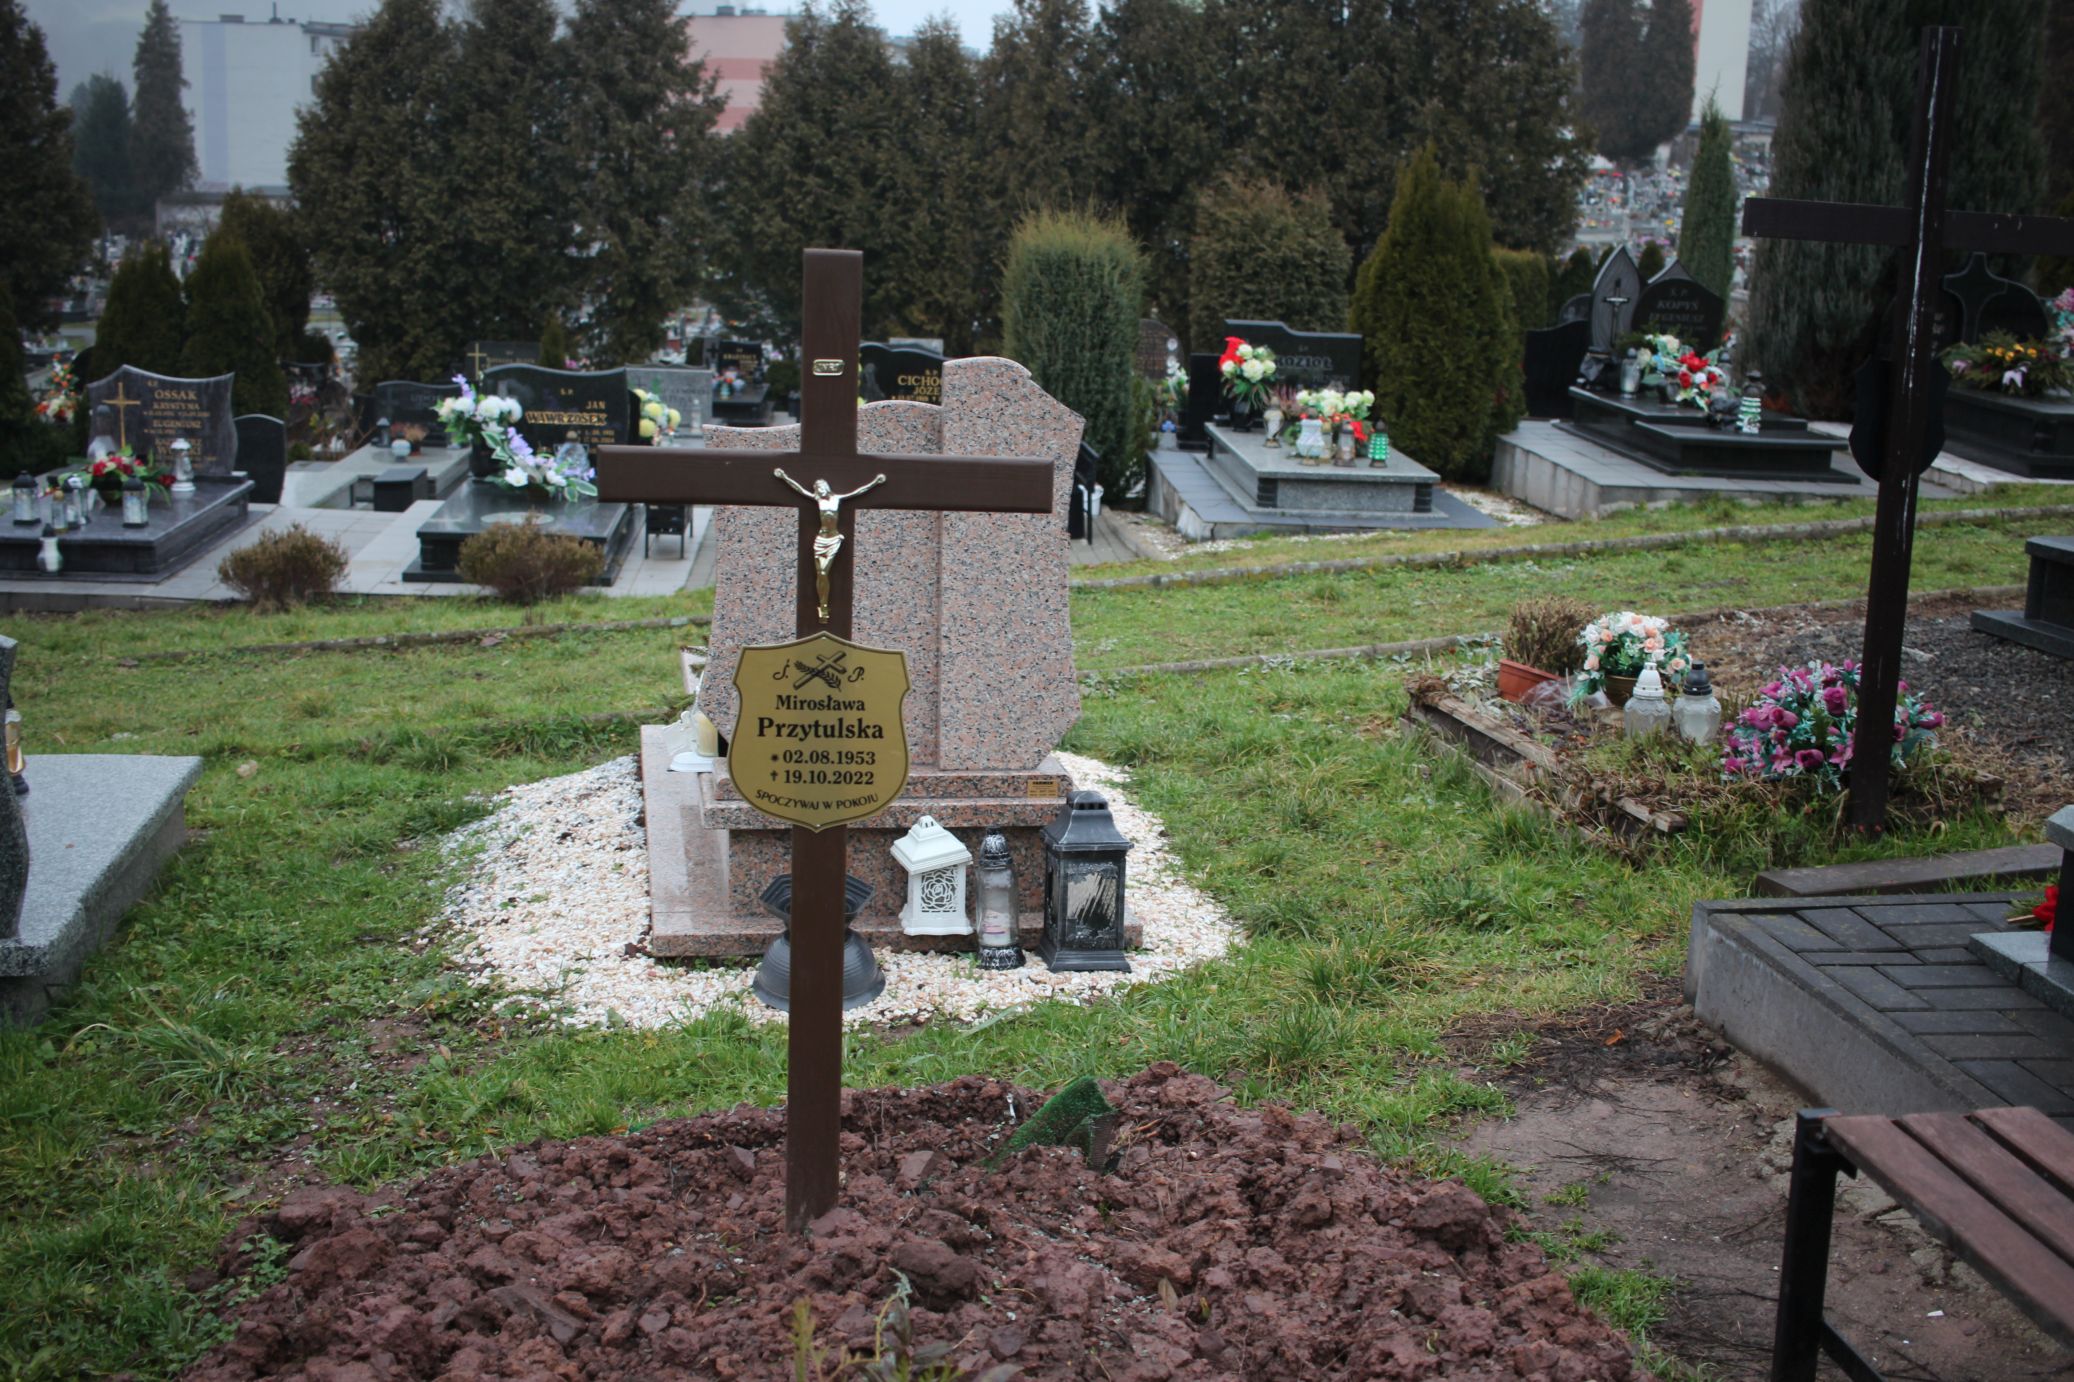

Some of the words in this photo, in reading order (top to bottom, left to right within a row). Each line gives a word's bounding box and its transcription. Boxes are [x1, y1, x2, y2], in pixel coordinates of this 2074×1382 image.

[897, 375, 942, 386] CICHO
[154, 389, 198, 400] OSSAK
[586, 401, 606, 410] JAN
[775, 694, 866, 711] Mirosława
[757, 716, 884, 742] Przytulska
[783, 749, 876, 765] 02.08.1953
[784, 769, 874, 785] 19.10.2022
[755, 789, 819, 810] SPOCZYWAJ
[822, 800, 833, 810] W
[836, 792, 879, 809] POKOJU
